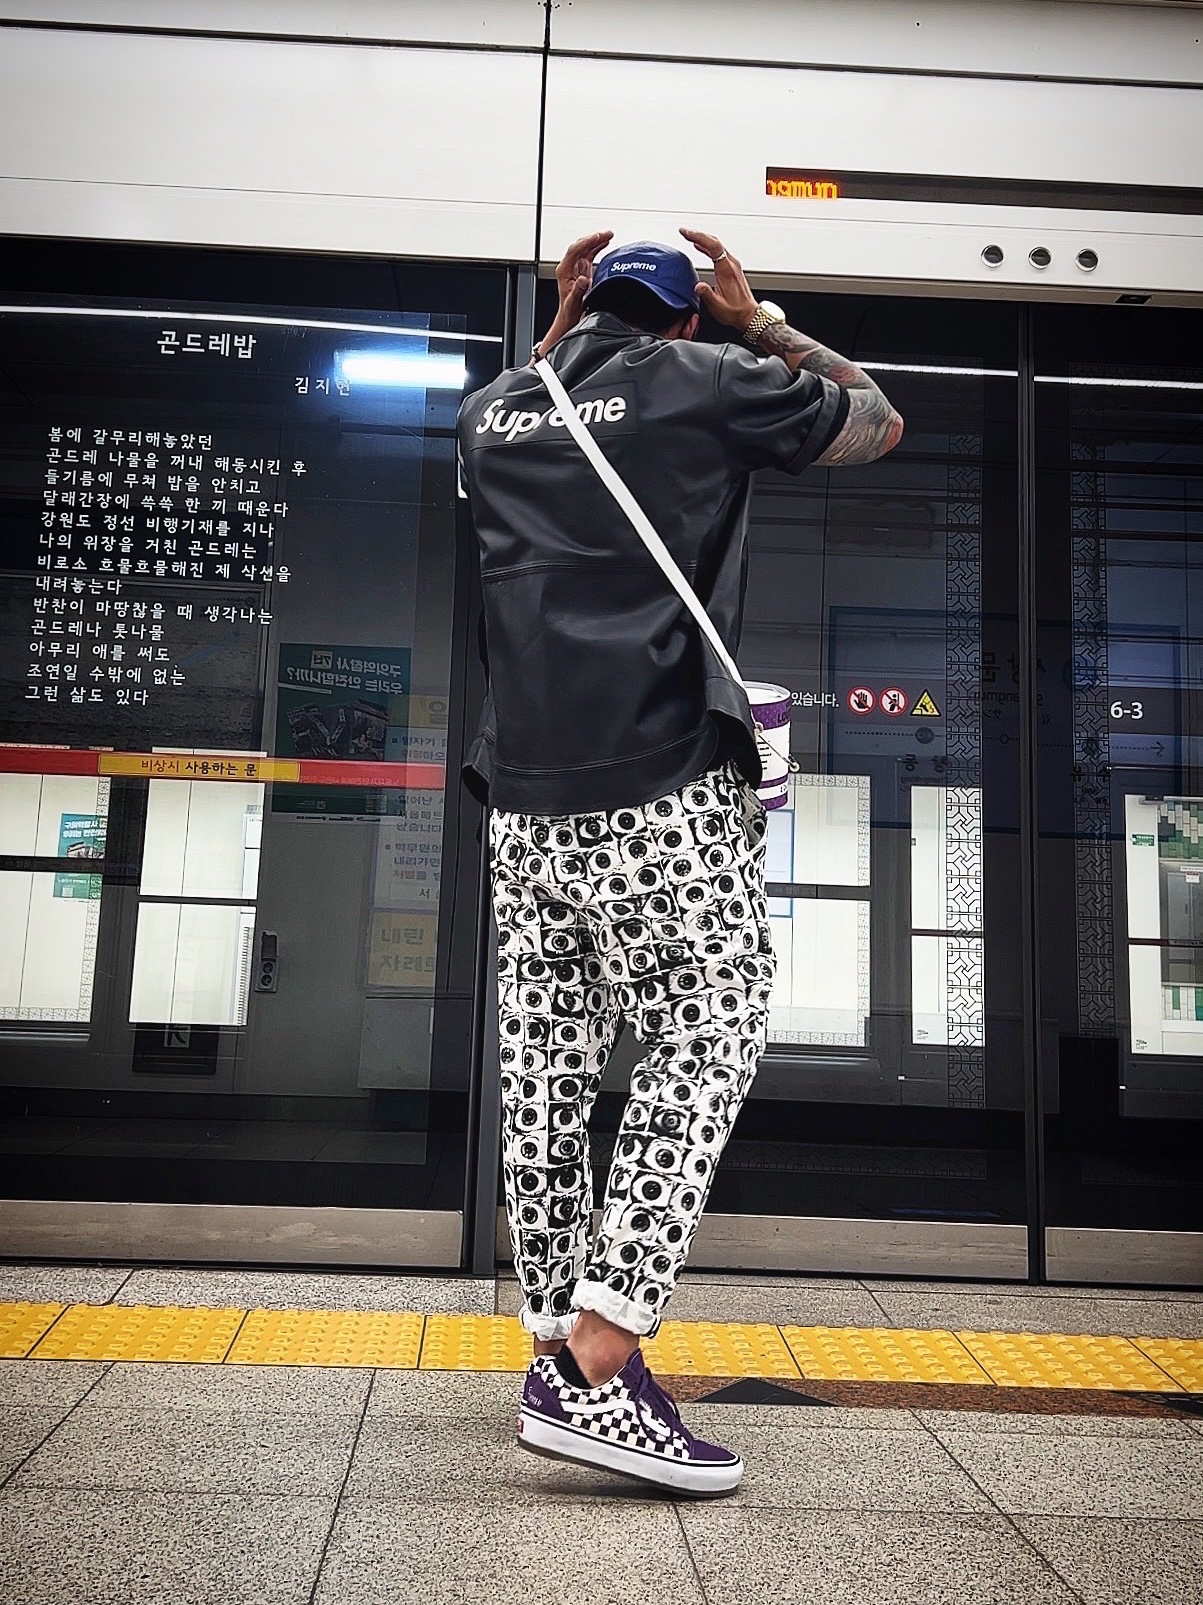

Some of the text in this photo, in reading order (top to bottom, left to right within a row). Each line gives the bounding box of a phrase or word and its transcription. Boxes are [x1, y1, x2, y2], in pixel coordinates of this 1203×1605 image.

[611, 262, 656, 272] Supreme
[157, 331, 257, 359] 곤드레밥
[48, 427, 211, 450] 봄에 갈무리해놓았던
[46, 448, 306, 476] 곤드레 나물을 꺼내 해동시킨 후
[45, 469, 260, 494] 들기름에 무쳐 밥을 안치고
[44, 490, 288, 517] 달래간장에 쓱쓱 한 끼 때운다
[41, 512, 274, 538] 강원도 정선 비행기재를 지나
[40, 533, 257, 559] 나의 위장을 거친 곤드레는
[38, 555, 87, 570] 비로소
[99, 558, 203, 578] 흐물흐물해진
[215, 564, 230, 579] 제
[35, 576, 122, 595] 내려놓는다
[34, 598, 272, 624] 반찬이 마땅찮을 때 생각나는
[31, 620, 165, 641] 곤드레나 톳나물
[30, 641, 169, 662] 아무리 애를 써도
[27, 664, 186, 686] 조연일 수밖에 없는
[25, 686, 149, 705] 그런 삶도 있다
[791, 692, 840, 708] 있습니다.
[1110, 701, 1143, 720] 6-3
[141, 760, 257, 777] 비상시 사용하는 문
